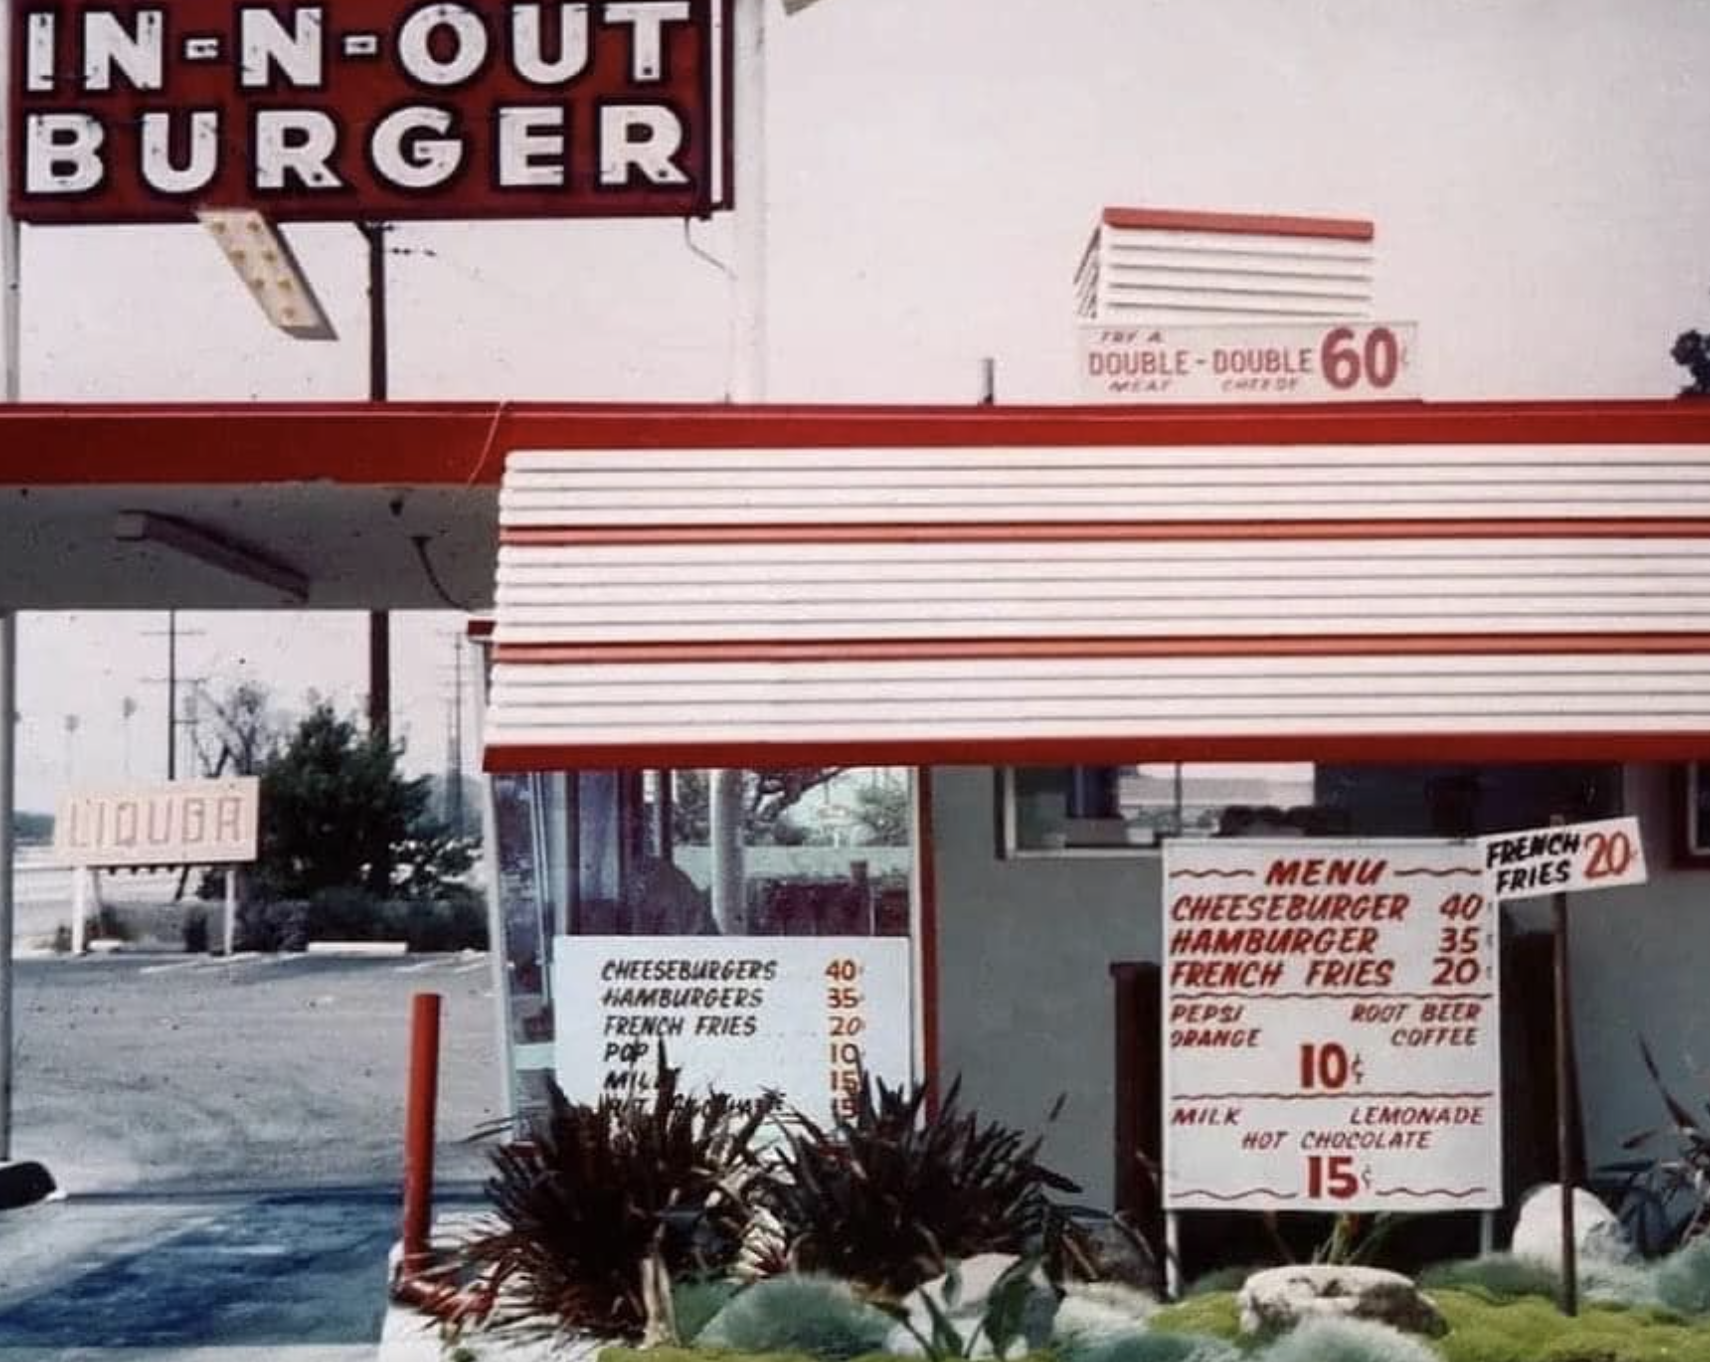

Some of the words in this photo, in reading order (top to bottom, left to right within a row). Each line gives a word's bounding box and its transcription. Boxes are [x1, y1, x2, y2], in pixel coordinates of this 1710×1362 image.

[27, 2, 690, 92] IN-N-OUT
[25, 106, 690, 194] BURGER
[1487, 833, 1580, 868] FRENCH
[1265, 859, 1388, 886] MENU
[1496, 860, 1570, 894] FRIES
[1170, 894, 1410, 922] CHEESEBURGER
[1169, 927, 1379, 955] HAMBURGER
[601, 959, 778, 981] CHEESEBURGERS
[1170, 960, 1284, 988] FRENCH
[1304, 959, 1396, 987] FRIES
[602, 988, 763, 1007] HAMBURGERS
[1170, 1004, 1244, 1023] PEPSI
[1351, 1004, 1409, 1023] ROOT
[1420, 1003, 1482, 1022] BEER
[603, 1016, 684, 1036] FRENCH
[695, 1016, 757, 1036] FRIES
[1170, 1029, 1262, 1048] ORANGE
[1391, 1028, 1478, 1046] COFFEE
[603, 1043, 649, 1062] POP
[603, 1070, 662, 1090] MIL
[1172, 1107, 1243, 1126] MILK
[1350, 1106, 1485, 1125] LEMONADE
[1242, 1131, 1288, 1150] HOT
[1301, 1130, 1432, 1149] CHOCOLATE
